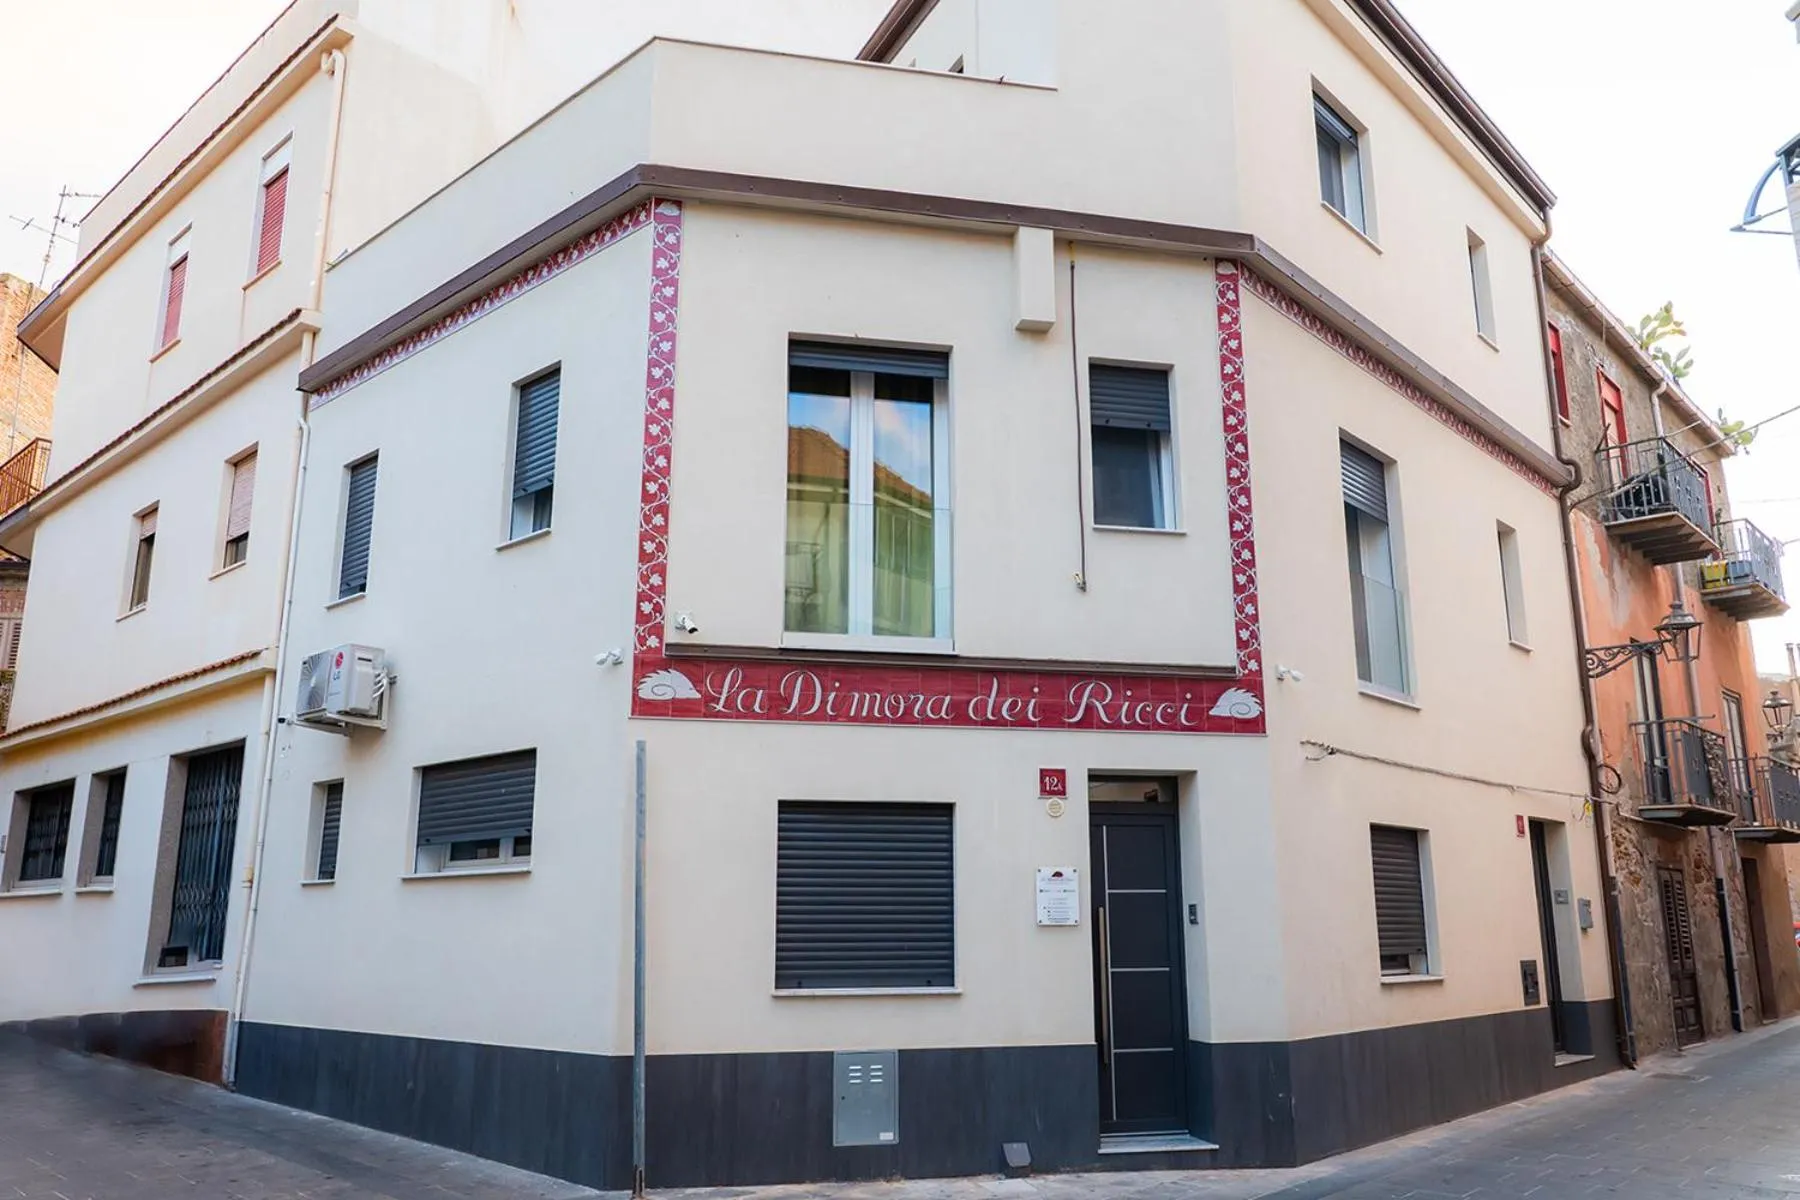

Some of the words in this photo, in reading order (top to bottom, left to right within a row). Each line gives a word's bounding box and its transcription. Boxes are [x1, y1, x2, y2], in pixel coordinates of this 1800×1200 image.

[706, 666, 768, 714] La
[780, 669, 956, 721] Dimora
[968, 676, 1043, 722] dei
[1063, 680, 1199, 727] Ricci
